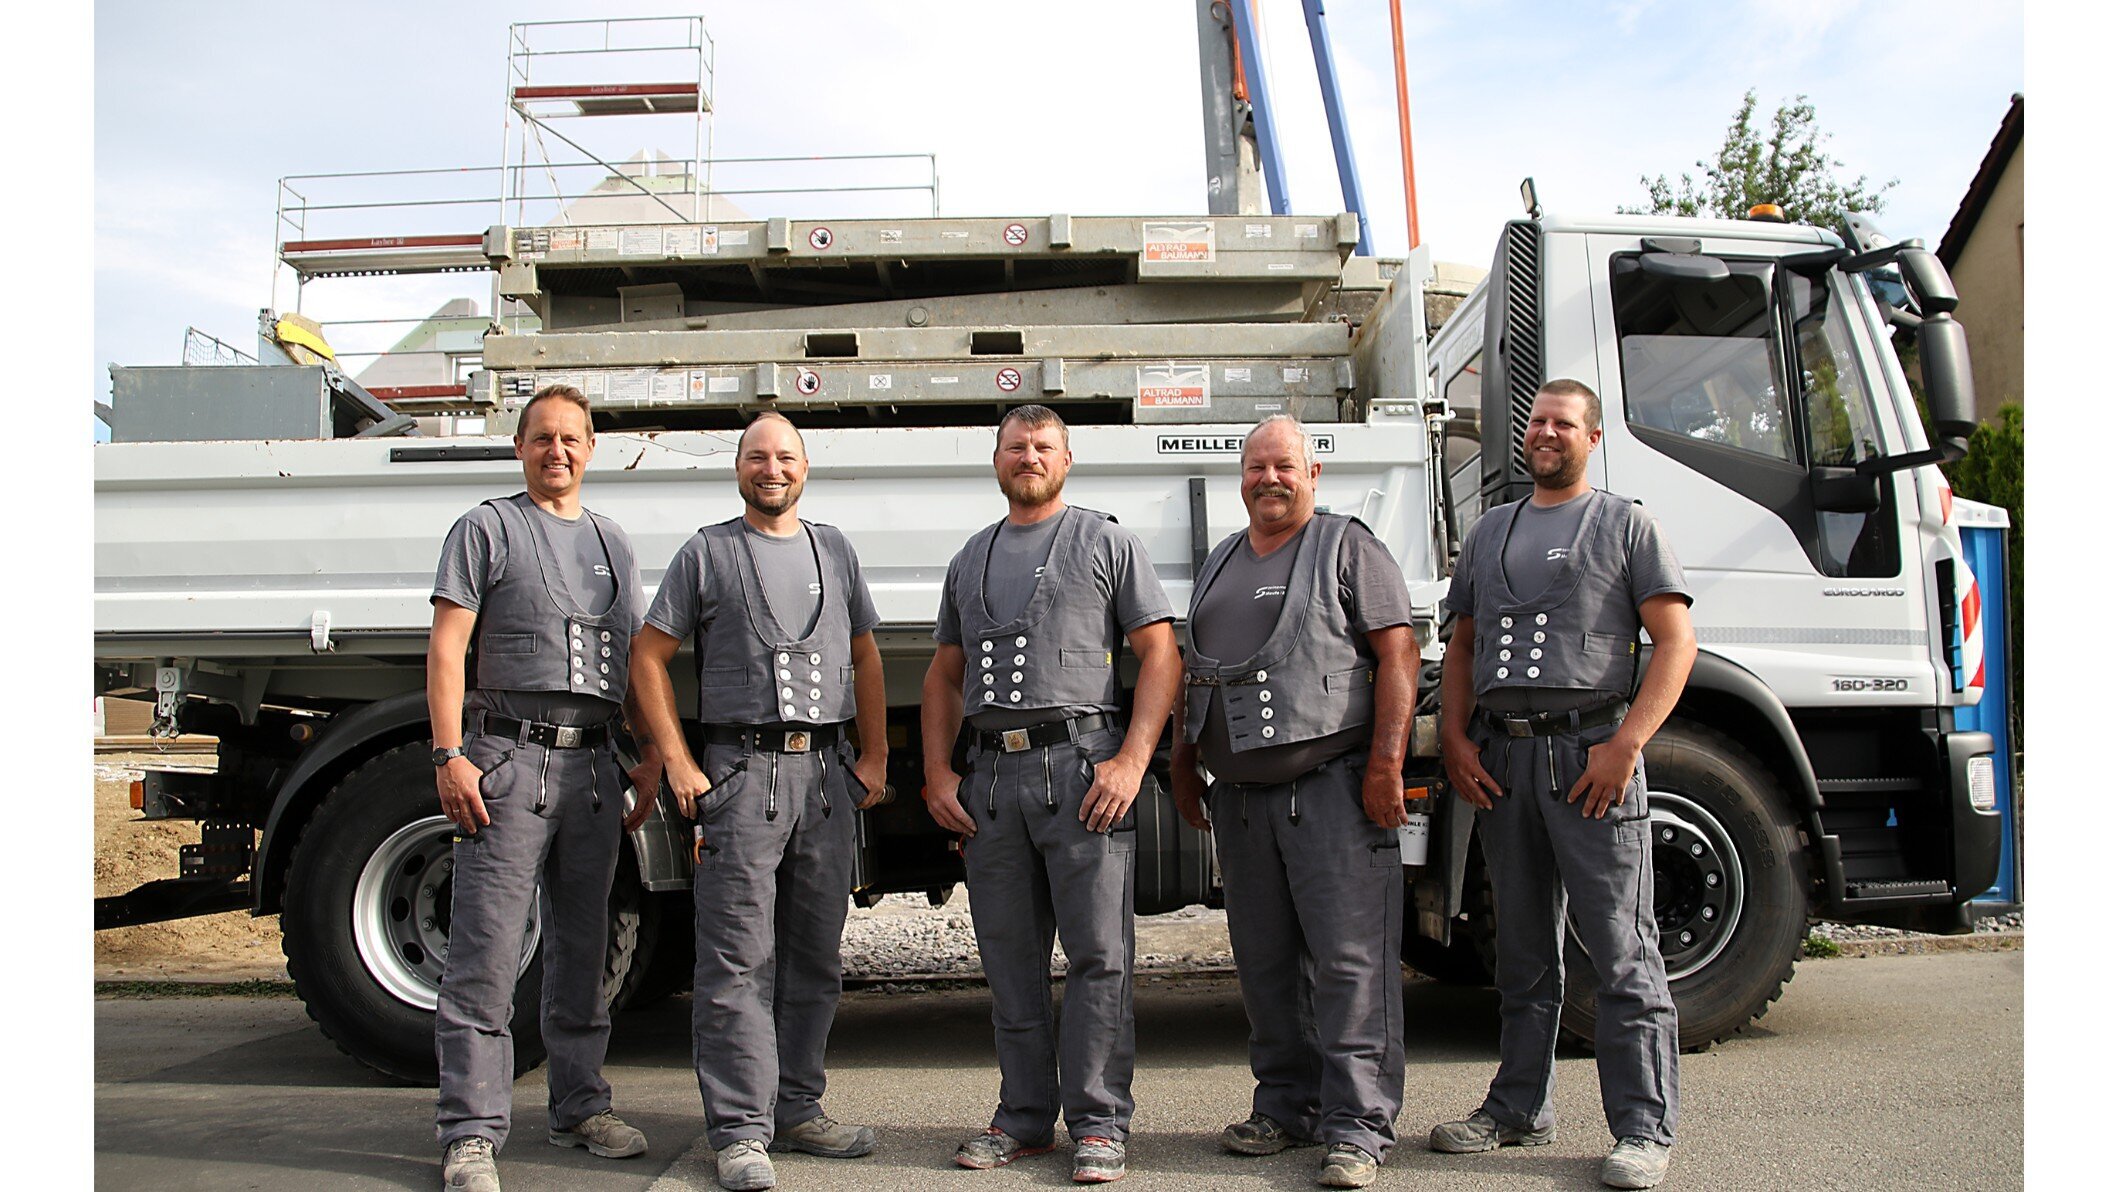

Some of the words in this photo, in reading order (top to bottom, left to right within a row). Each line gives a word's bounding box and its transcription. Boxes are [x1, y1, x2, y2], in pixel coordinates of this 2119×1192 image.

[1149, 243, 1187, 252] ALTRAD
[1160, 251, 1208, 260] BAUMANN
[1143, 388, 1182, 397] ALTRAD
[1154, 396, 1202, 405] BAUMANN
[1161, 439, 1243, 450] MEILLE
[1823, 587, 1905, 597] EUROCARGO
[1831, 679, 1909, 692] 160-320
